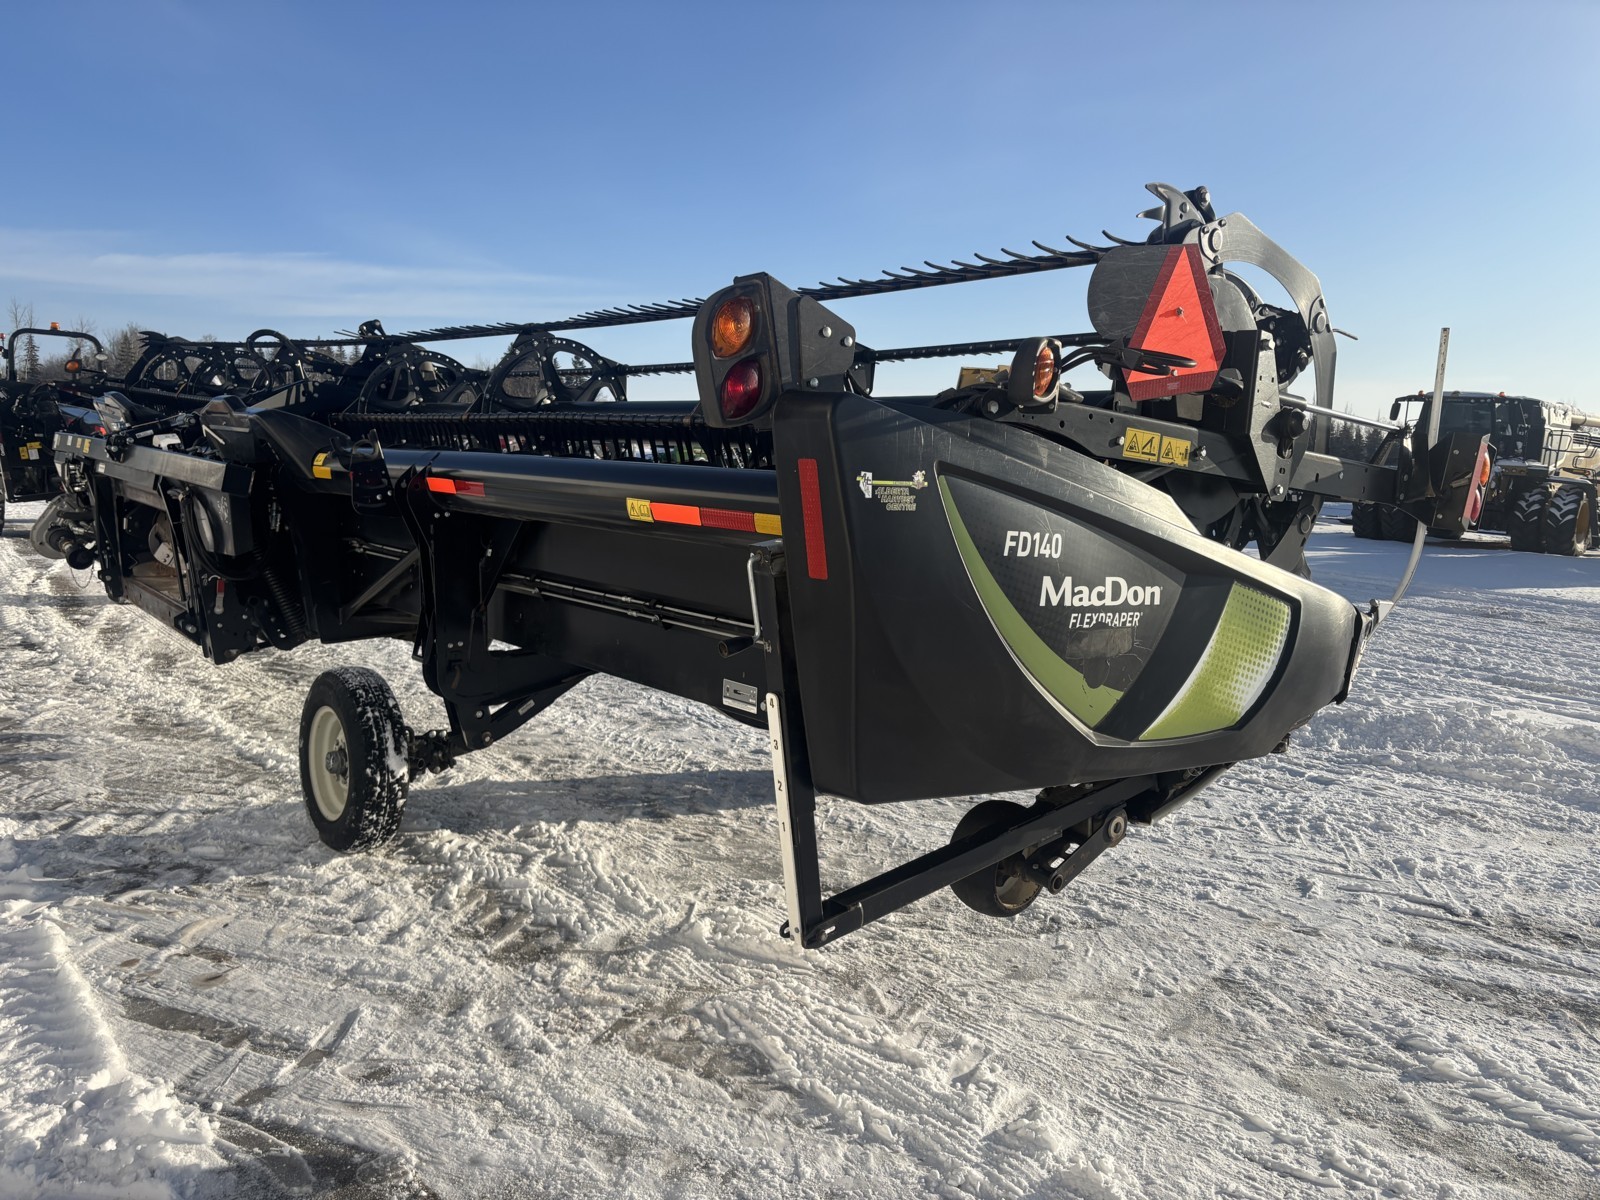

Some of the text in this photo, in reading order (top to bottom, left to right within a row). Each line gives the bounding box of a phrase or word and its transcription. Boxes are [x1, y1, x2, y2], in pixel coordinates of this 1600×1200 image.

[874, 486, 910, 498] ALBERTA
[885, 503, 917, 511] CENTRE
[1003, 530, 1063, 559] FD140
[1039, 575, 1161, 607] MacDon
[1068, 611, 1141, 629] FLEXDRAPER
[769, 697, 775, 709] 4
[773, 739, 779, 751] 3
[777, 779, 783, 792] 2
[781, 821, 786, 832] 1
